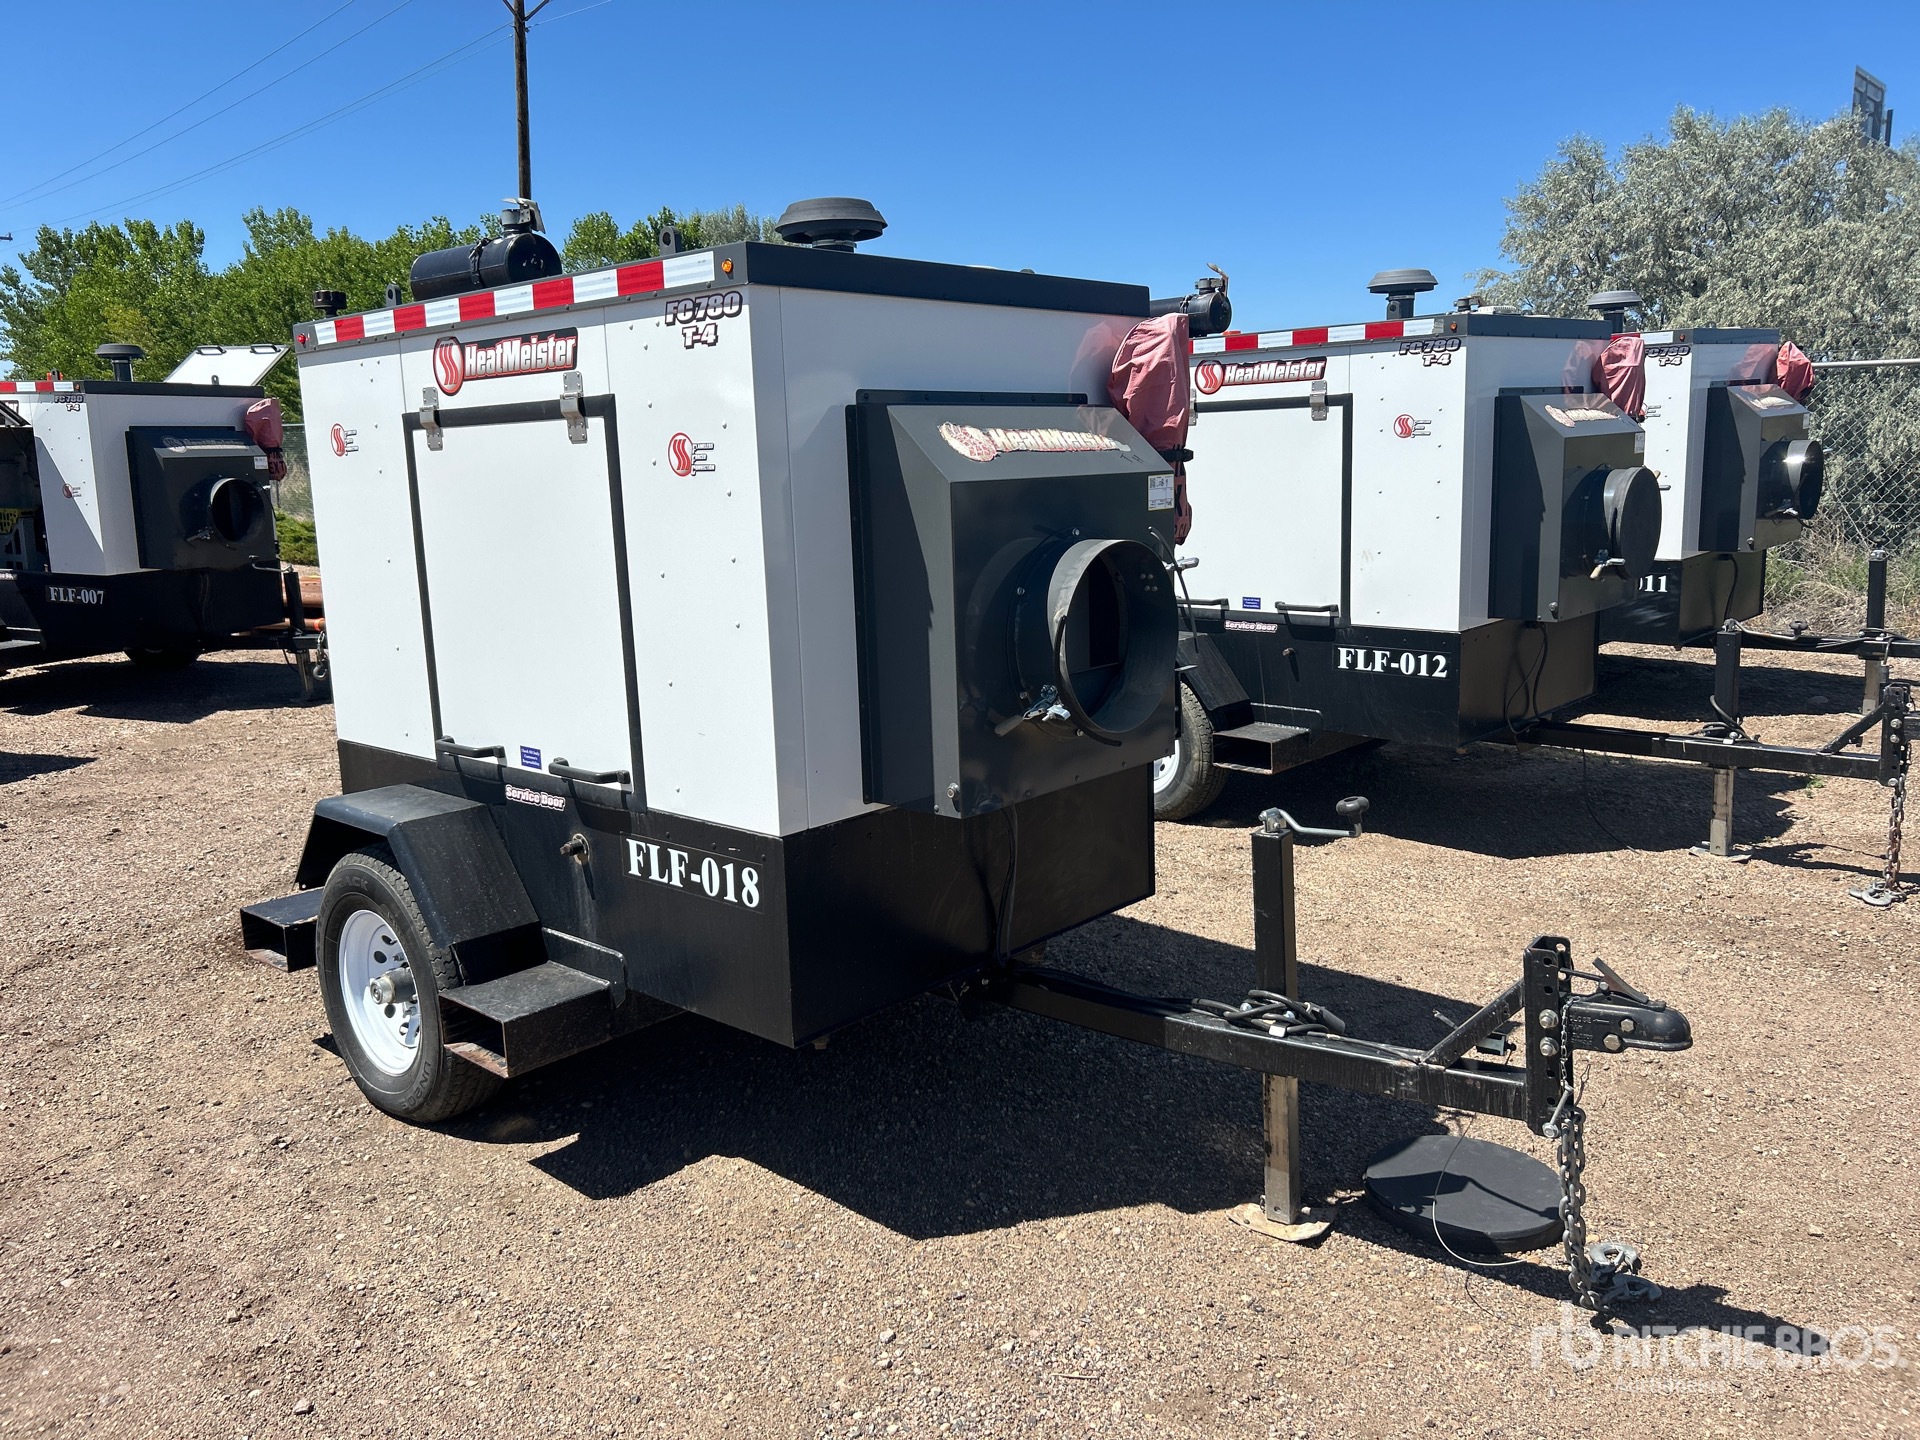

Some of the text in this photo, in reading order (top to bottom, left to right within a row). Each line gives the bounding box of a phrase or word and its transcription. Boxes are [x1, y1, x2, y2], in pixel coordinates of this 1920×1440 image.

[664, 290, 744, 327] FC780
[682, 322, 719, 350] T-4
[1398, 337, 1462, 356] FC780
[464, 333, 577, 379] HeatMeister
[1422, 352, 1452, 367] T-4
[1224, 360, 1327, 384] HeatMeister
[49, 587, 104, 605] FLF-007
[1337, 647, 1448, 678] FLF-012
[506, 785, 566, 811] Service Door
[626, 838, 760, 908] FLF-018
